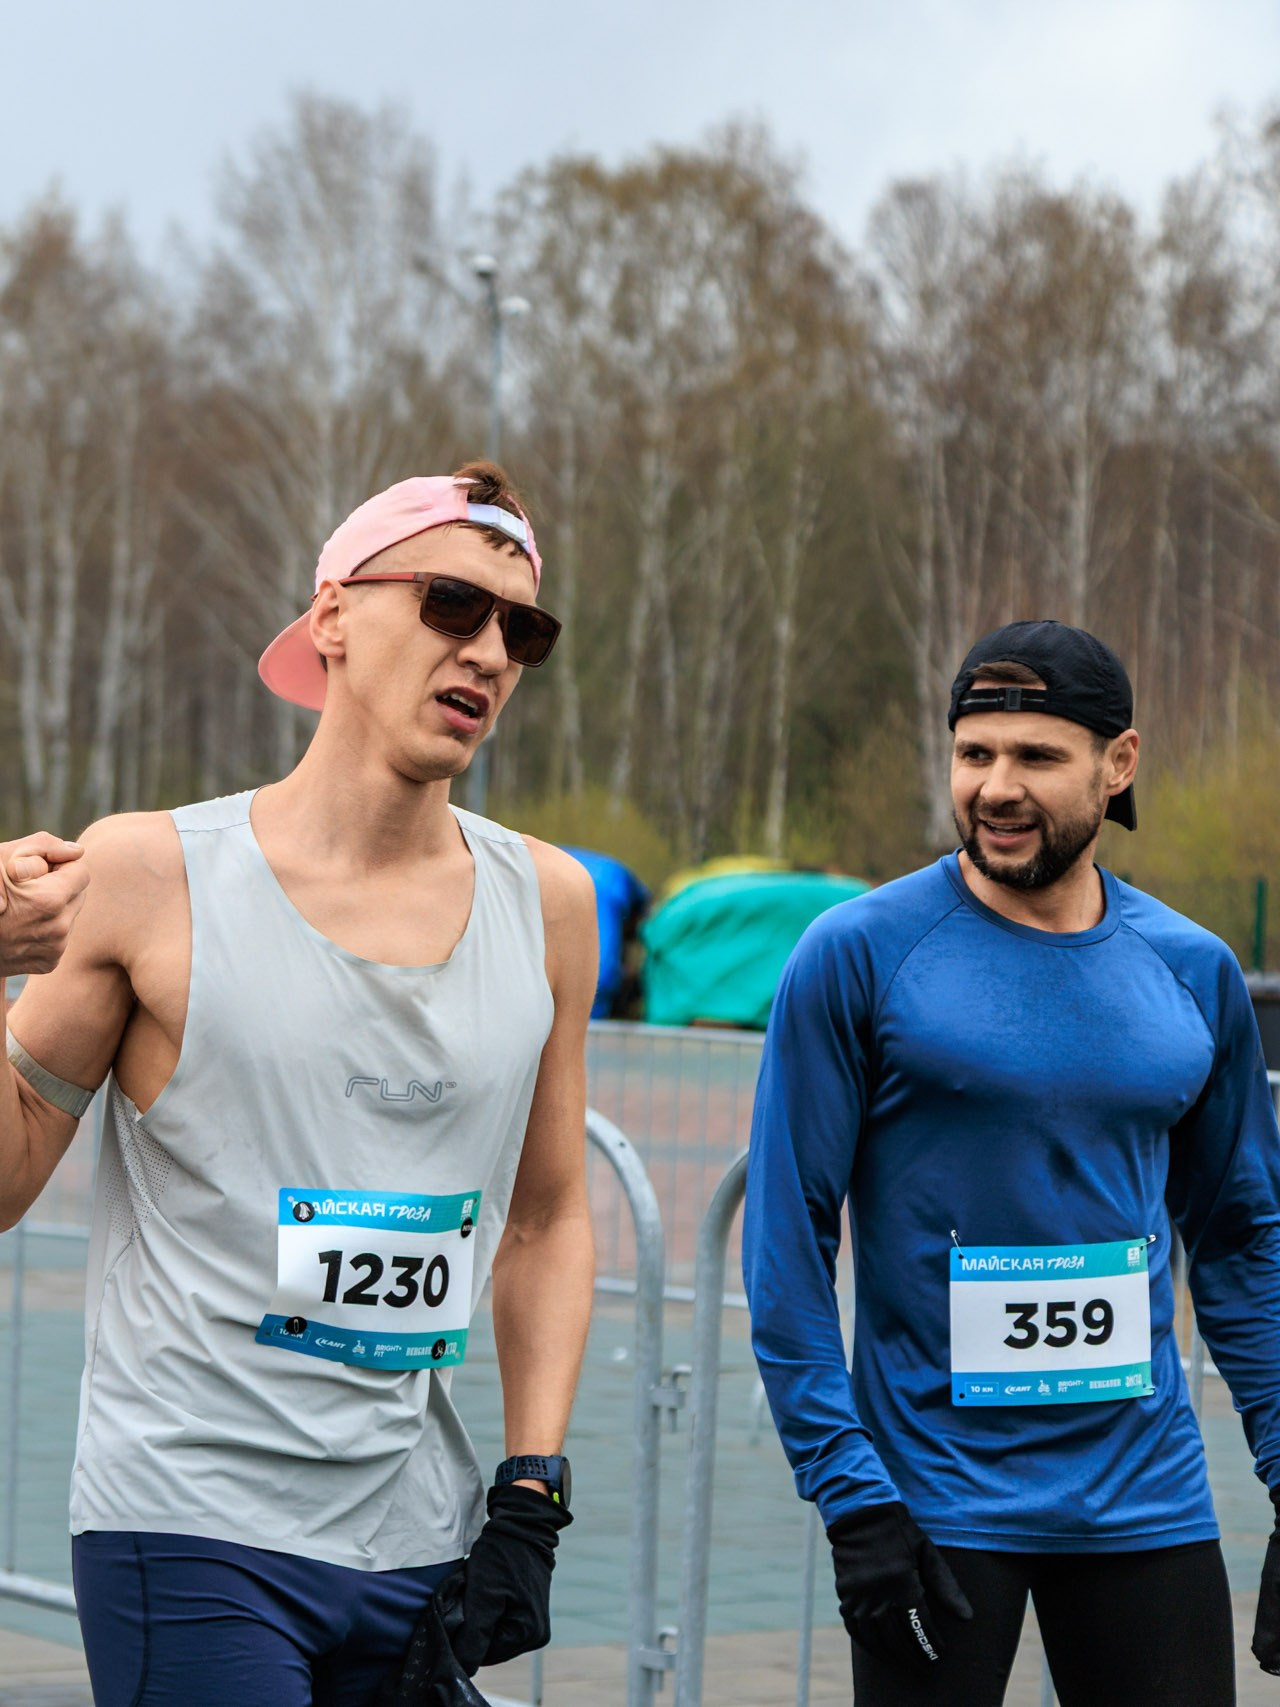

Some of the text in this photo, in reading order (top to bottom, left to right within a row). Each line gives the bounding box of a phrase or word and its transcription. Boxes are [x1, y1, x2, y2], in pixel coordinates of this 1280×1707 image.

[292, 1198, 386, 1218] АЙСКАЯ
[318, 1250, 450, 1308] 1230
[962, 1255, 1086, 1271] МАЙСКАЯ ГРОЗА
[1003, 1298, 1115, 1350] 359
[970, 1385, 981, 1393] 10
[908, 1608, 939, 1661] NORDSKI
